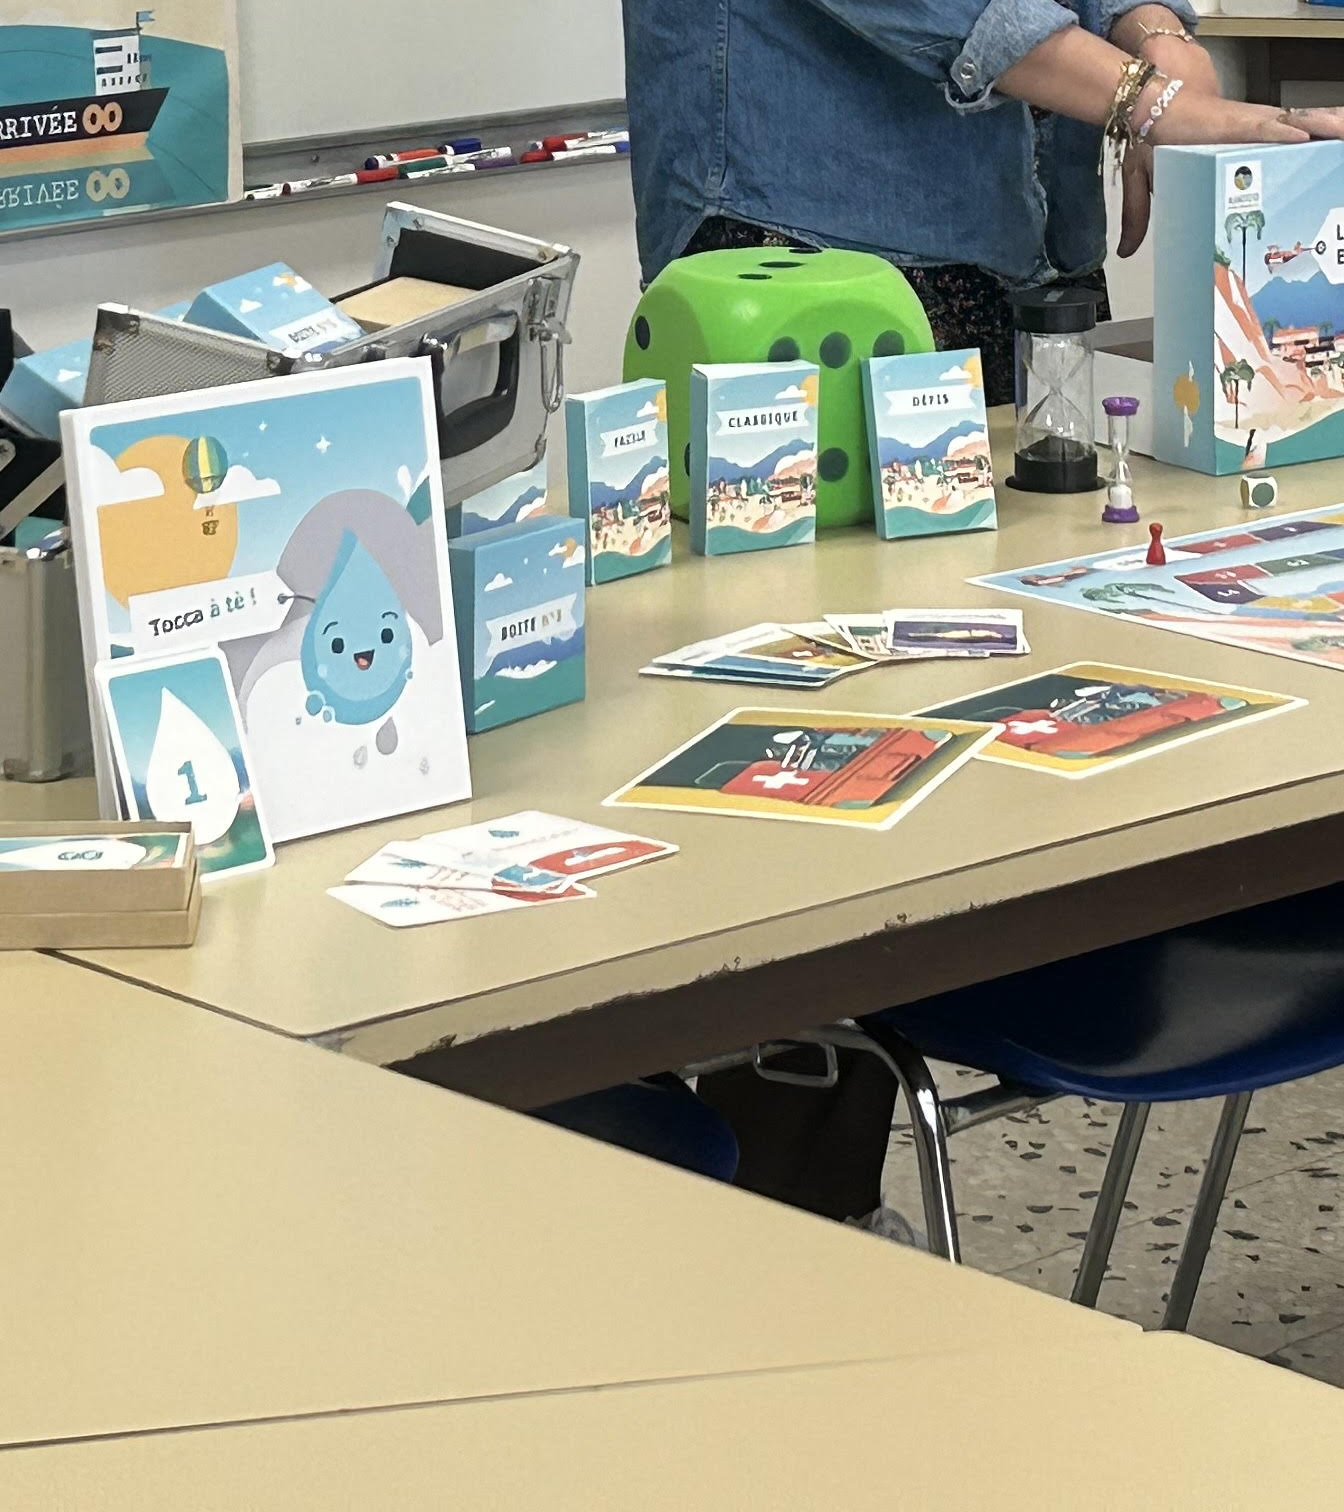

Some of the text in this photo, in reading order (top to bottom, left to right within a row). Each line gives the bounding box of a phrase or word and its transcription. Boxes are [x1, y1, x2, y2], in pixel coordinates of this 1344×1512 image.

[728, 410, 799, 428] CLASSIQUE
[147, 609, 204, 638] Tocca
[209, 598, 221, 619] à
[501, 616, 537, 641] BOITE
[176, 760, 208, 807] 1
